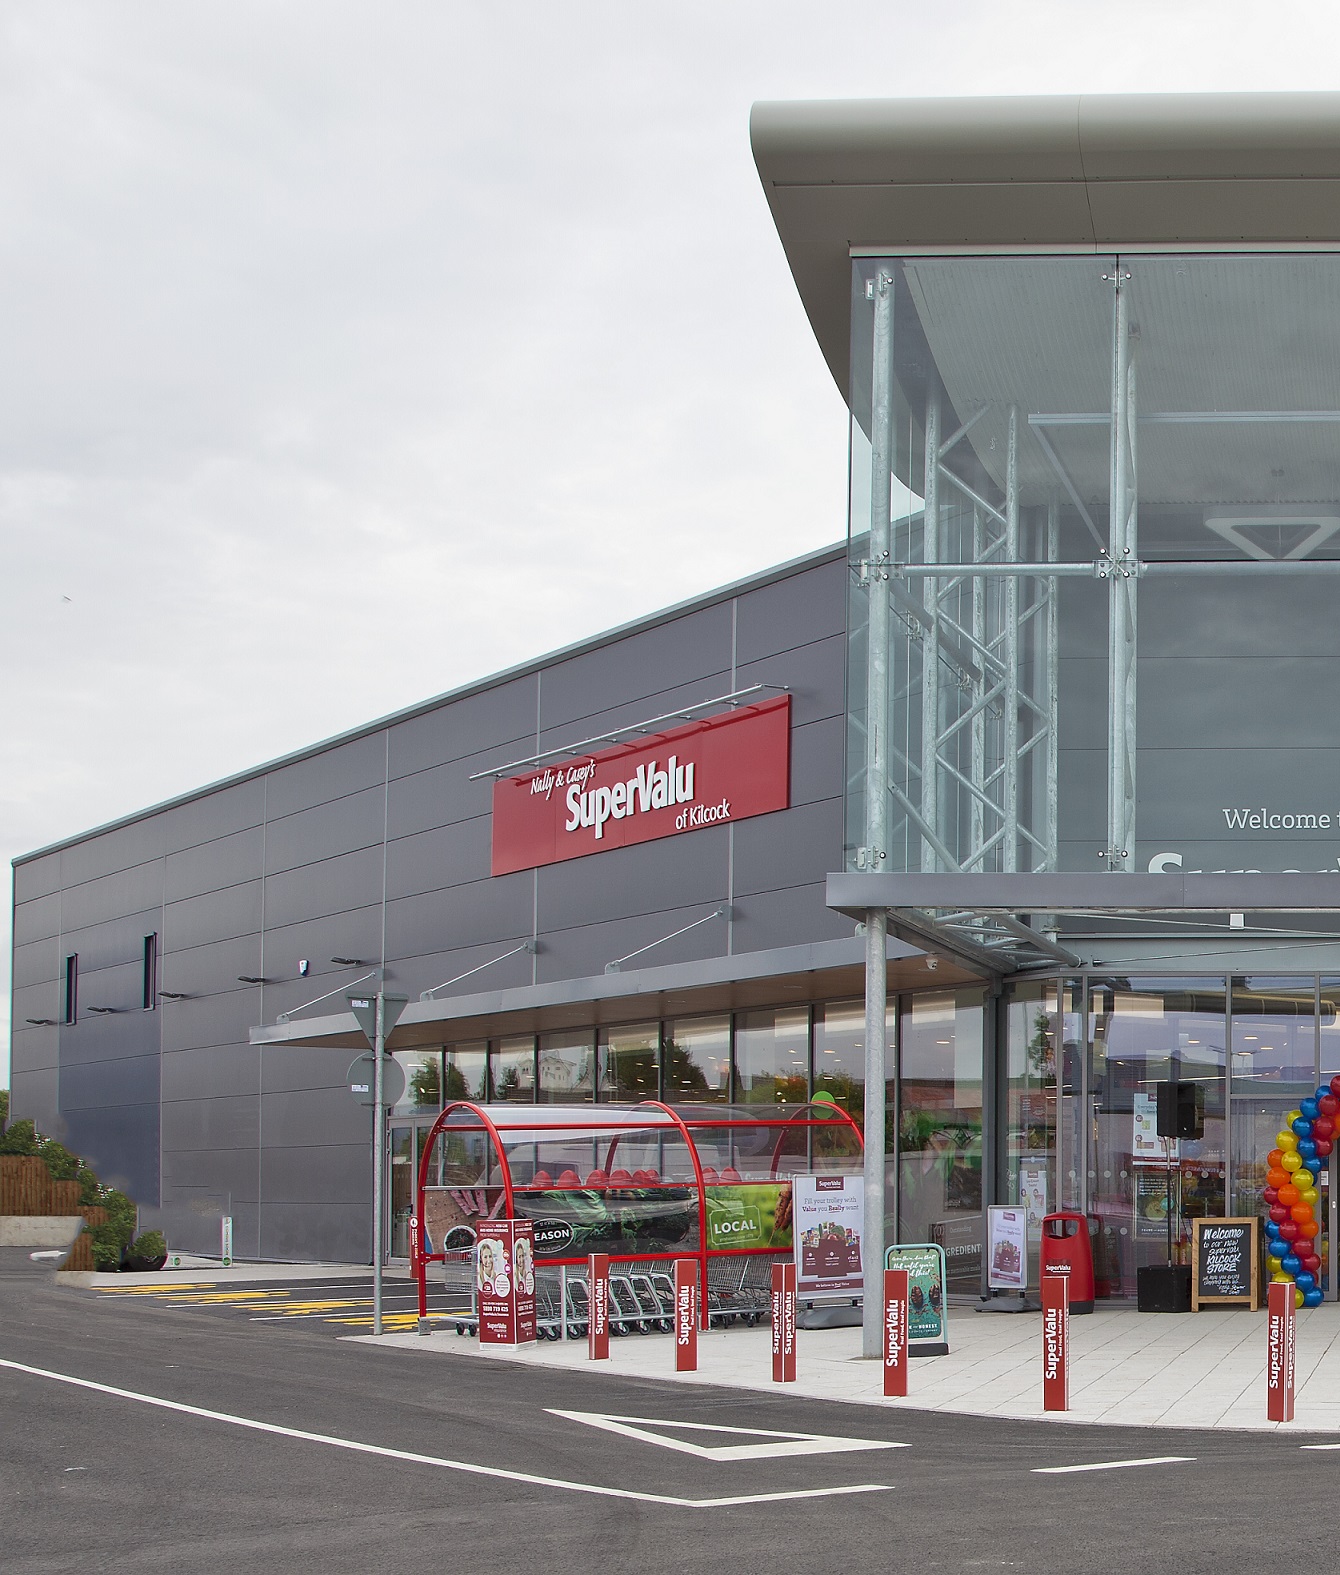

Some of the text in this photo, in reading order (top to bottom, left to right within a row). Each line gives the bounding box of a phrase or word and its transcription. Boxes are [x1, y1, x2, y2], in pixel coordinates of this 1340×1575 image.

[530, 759, 597, 801] Nally & Casey's
[565, 755, 695, 839] SuperValu
[675, 798, 731, 830] of Kilcock
[1222, 808, 1331, 829] Welcome
[534, 1229, 570, 1241] EASON
[714, 1219, 757, 1235] LOCAL
[1204, 1228, 1243, 1239] Welcome
[1207, 1253, 1241, 1264] KILCOCK
[1207, 1263, 1236, 1273] STORE
[595, 1279, 605, 1334] SuperValu
[679, 1286, 692, 1345] SuperValu
[785, 1292, 794, 1355] SuperValu
[886, 1299, 901, 1367] SuperValu
[1046, 1309, 1060, 1379] SuperValu
[1270, 1316, 1280, 1389] SuperValu
